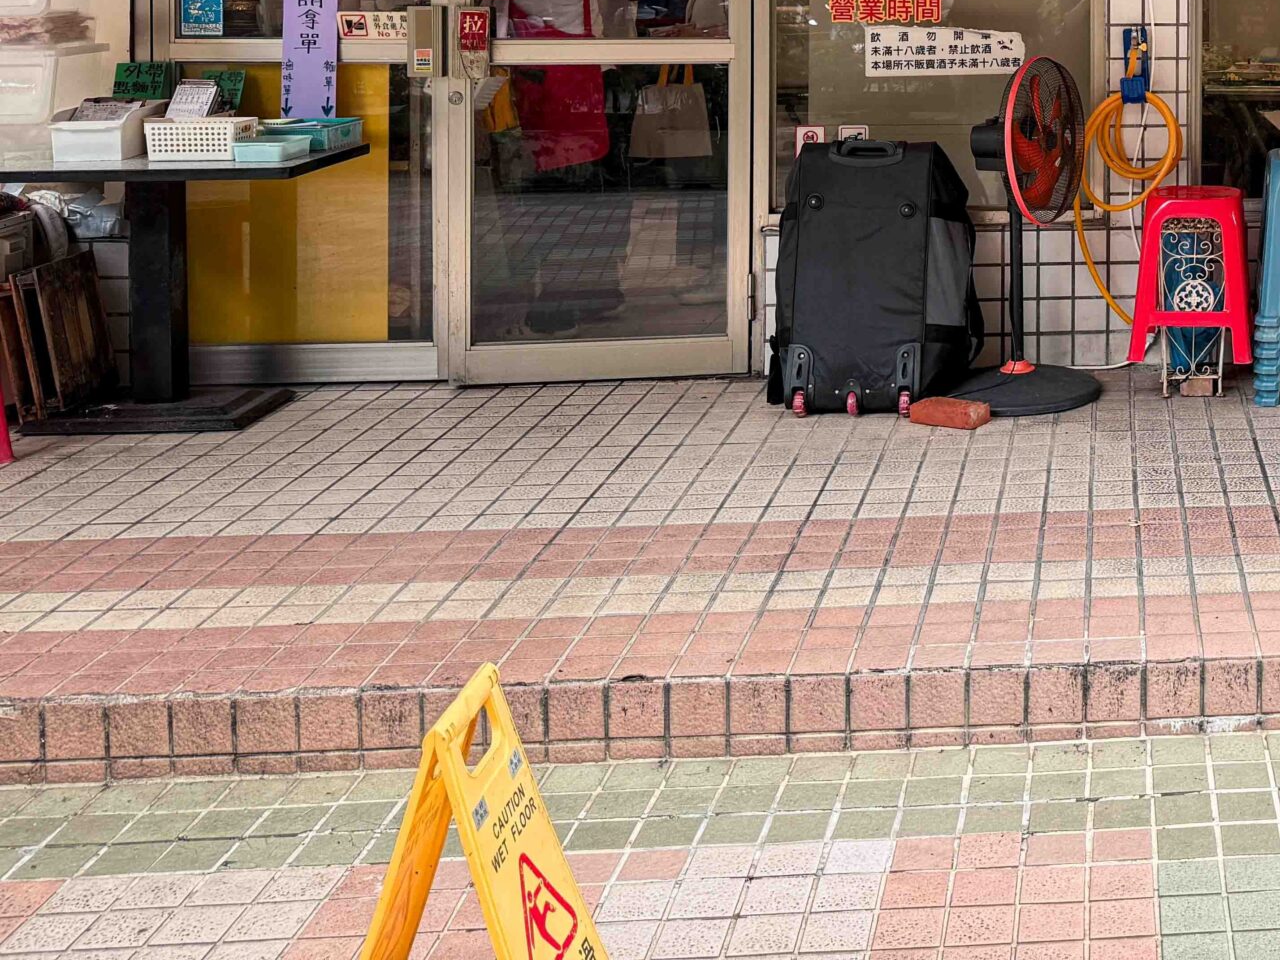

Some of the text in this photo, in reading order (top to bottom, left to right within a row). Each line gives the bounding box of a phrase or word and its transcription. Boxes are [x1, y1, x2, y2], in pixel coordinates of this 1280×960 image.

[463, 15, 484, 34] 拉
[491, 797, 537, 873] WET FLOOR
[492, 783, 526, 840] CAUTION
